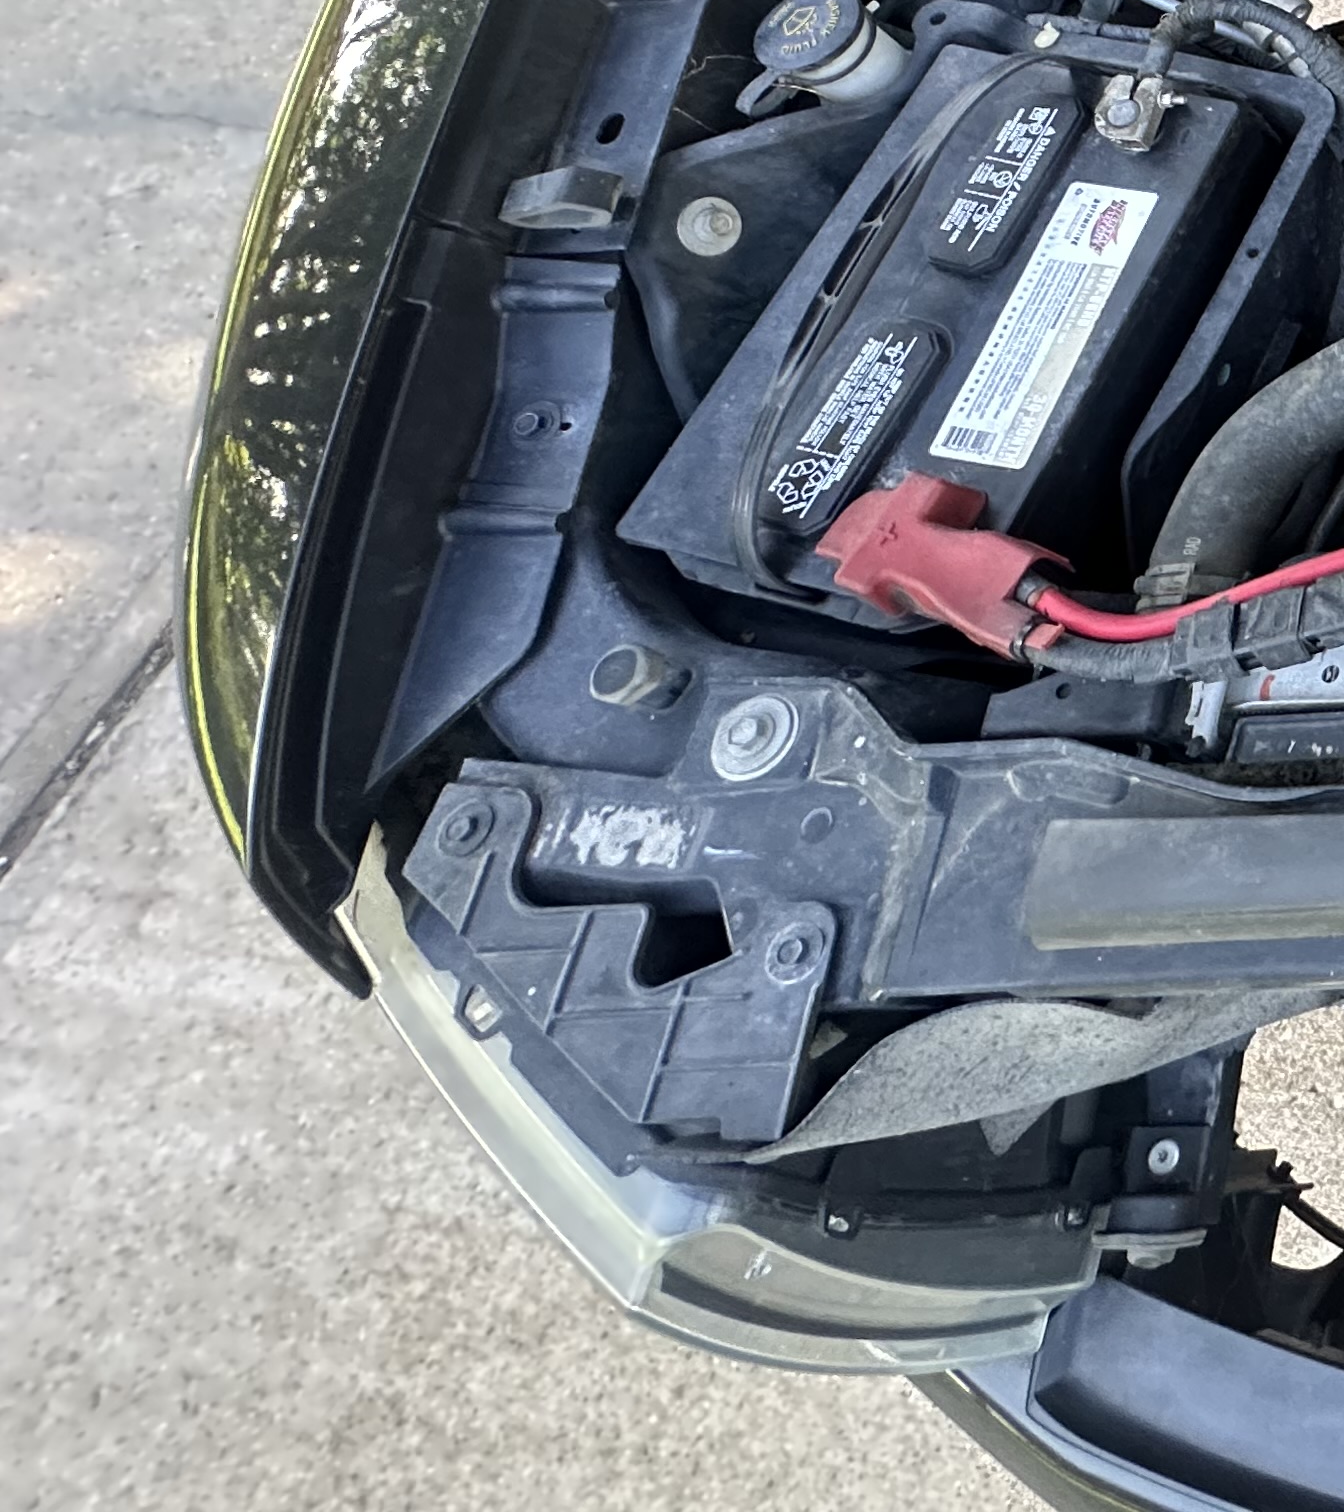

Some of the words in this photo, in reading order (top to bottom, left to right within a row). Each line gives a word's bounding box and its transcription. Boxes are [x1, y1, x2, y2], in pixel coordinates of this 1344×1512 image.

[1016, 137, 1052, 183] DANGER
[984, 189, 1019, 234] POISON
[1183, 536, 1202, 556] RAD
